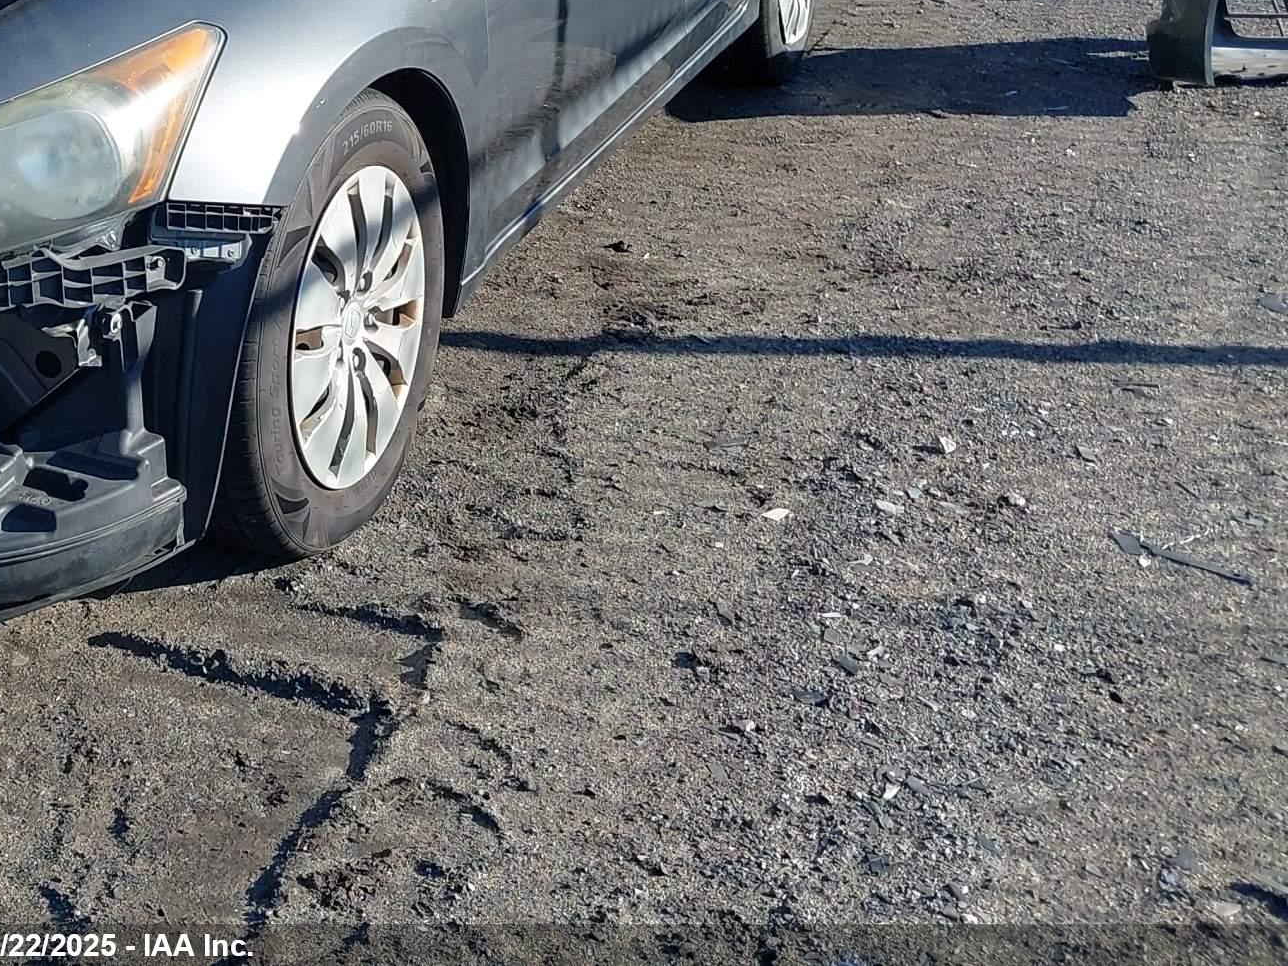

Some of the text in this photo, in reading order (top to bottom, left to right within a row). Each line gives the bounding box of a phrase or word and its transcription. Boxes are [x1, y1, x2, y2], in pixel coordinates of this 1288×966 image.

[342, 120, 393, 155] 215/60R16
[267, 337, 285, 477] Touring Sport
